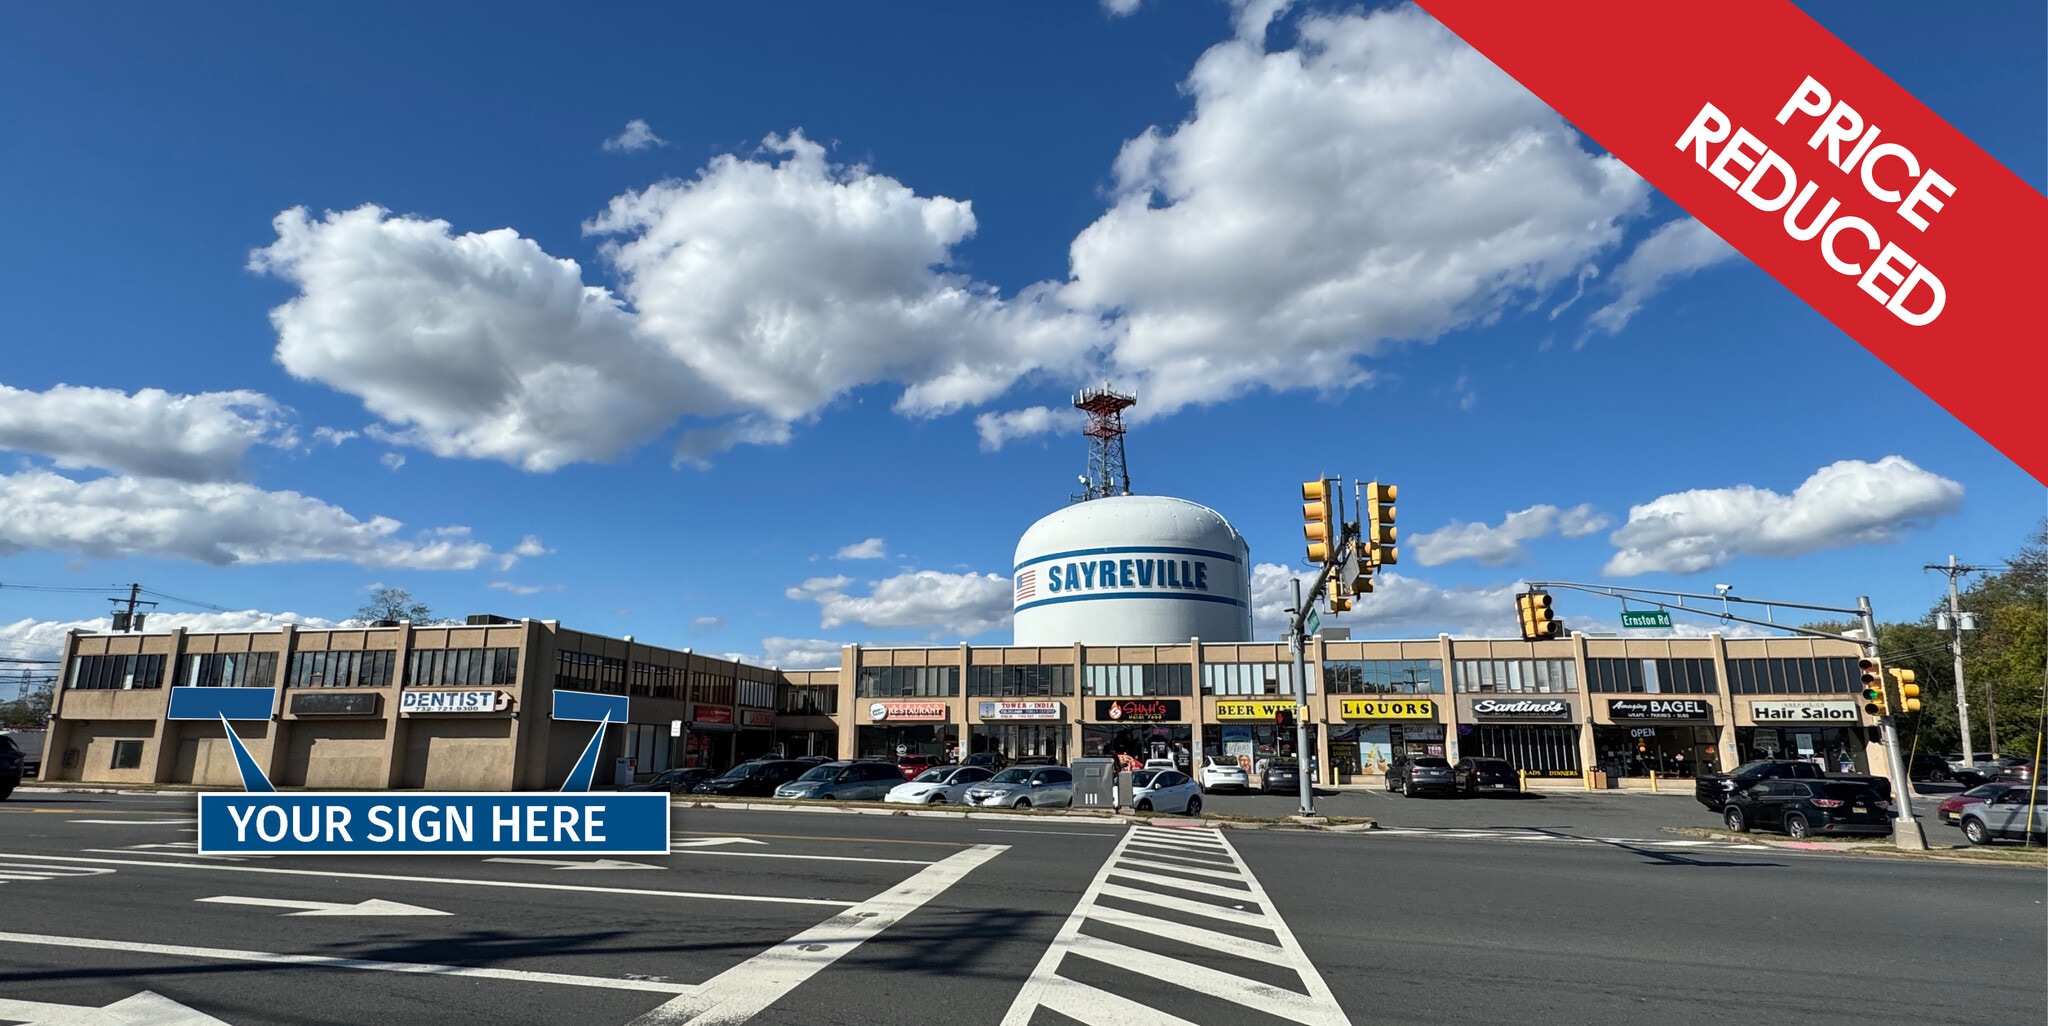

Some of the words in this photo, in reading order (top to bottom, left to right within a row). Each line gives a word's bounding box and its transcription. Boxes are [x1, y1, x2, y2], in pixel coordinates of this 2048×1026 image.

[1048, 559, 1208, 593] SAYREVILLE
[1623, 614, 1656, 626] Ernston
[1657, 614, 1670, 625] Rd
[403, 692, 492, 706] DENTIST
[1218, 705, 1255, 715] BEER
[1343, 703, 1429, 715] LIQUORS
[1475, 700, 1563, 712] Santino's
[1612, 701, 1647, 711] Amazing
[1650, 701, 1704, 713] BAGEL
[1754, 708, 1795, 719] Hair
[1801, 708, 1854, 719] Salon
[1631, 728, 1655, 738] OPEN
